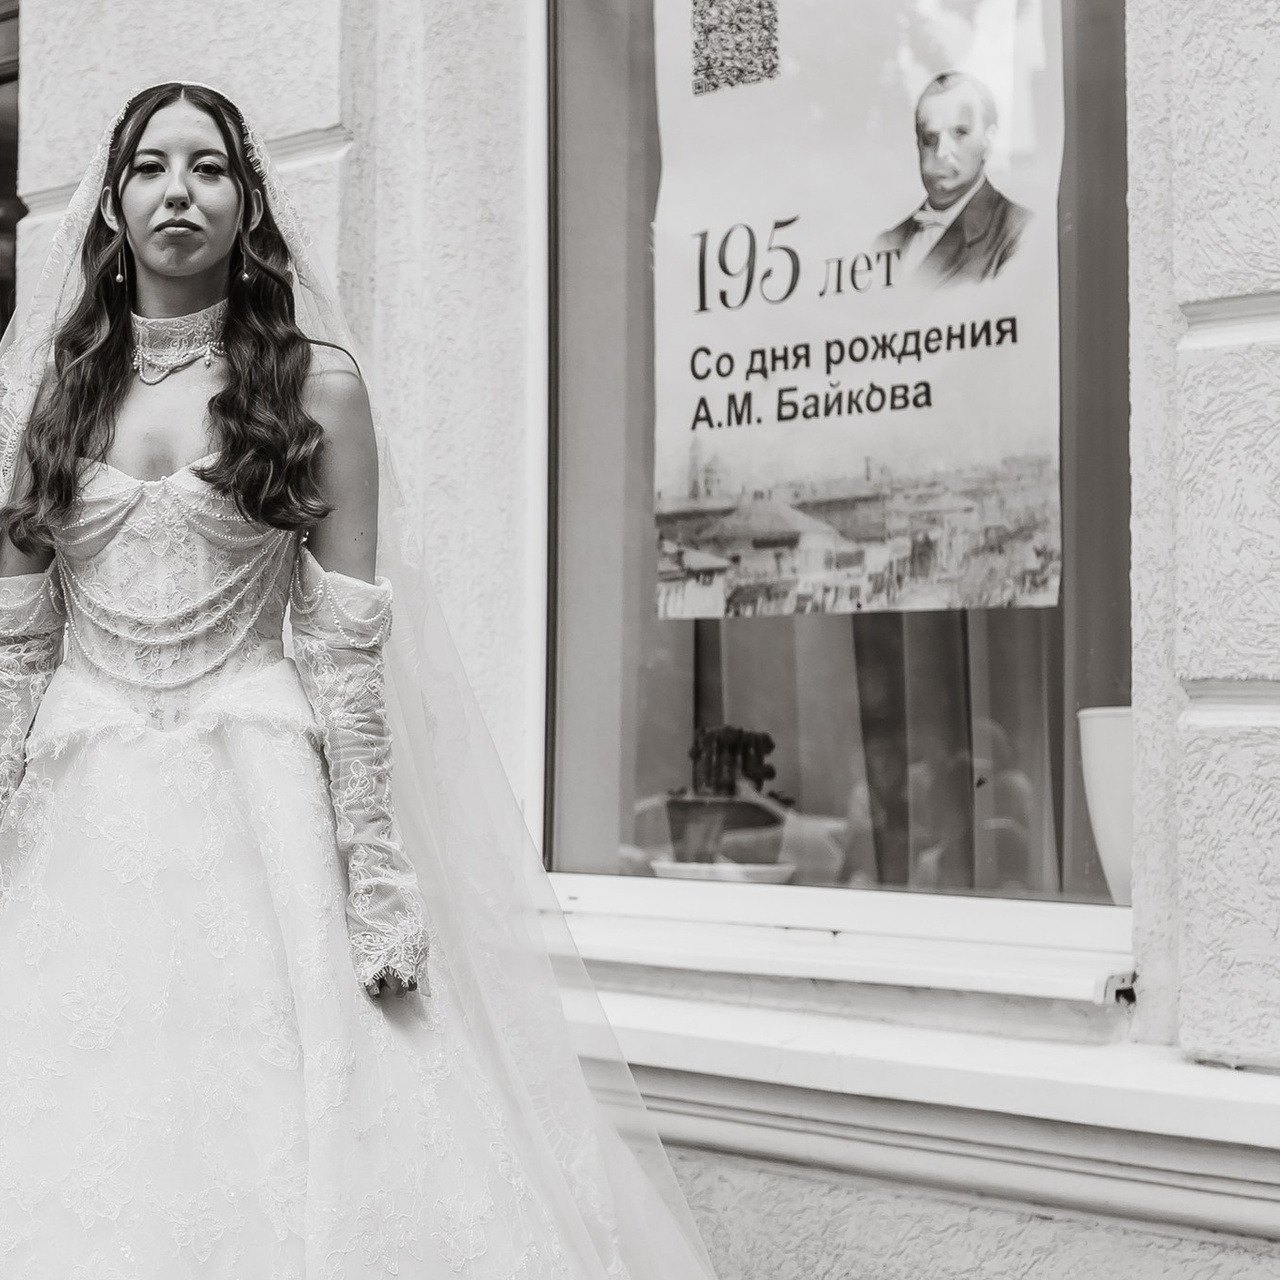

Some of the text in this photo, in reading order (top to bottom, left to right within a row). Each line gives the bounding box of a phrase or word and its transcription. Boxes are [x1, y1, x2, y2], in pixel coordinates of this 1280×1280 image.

[691, 216, 901, 314] 195 лет
[690, 316, 1018, 381] Со дня рождения
[691, 379, 932, 431] А.М. Байкова
